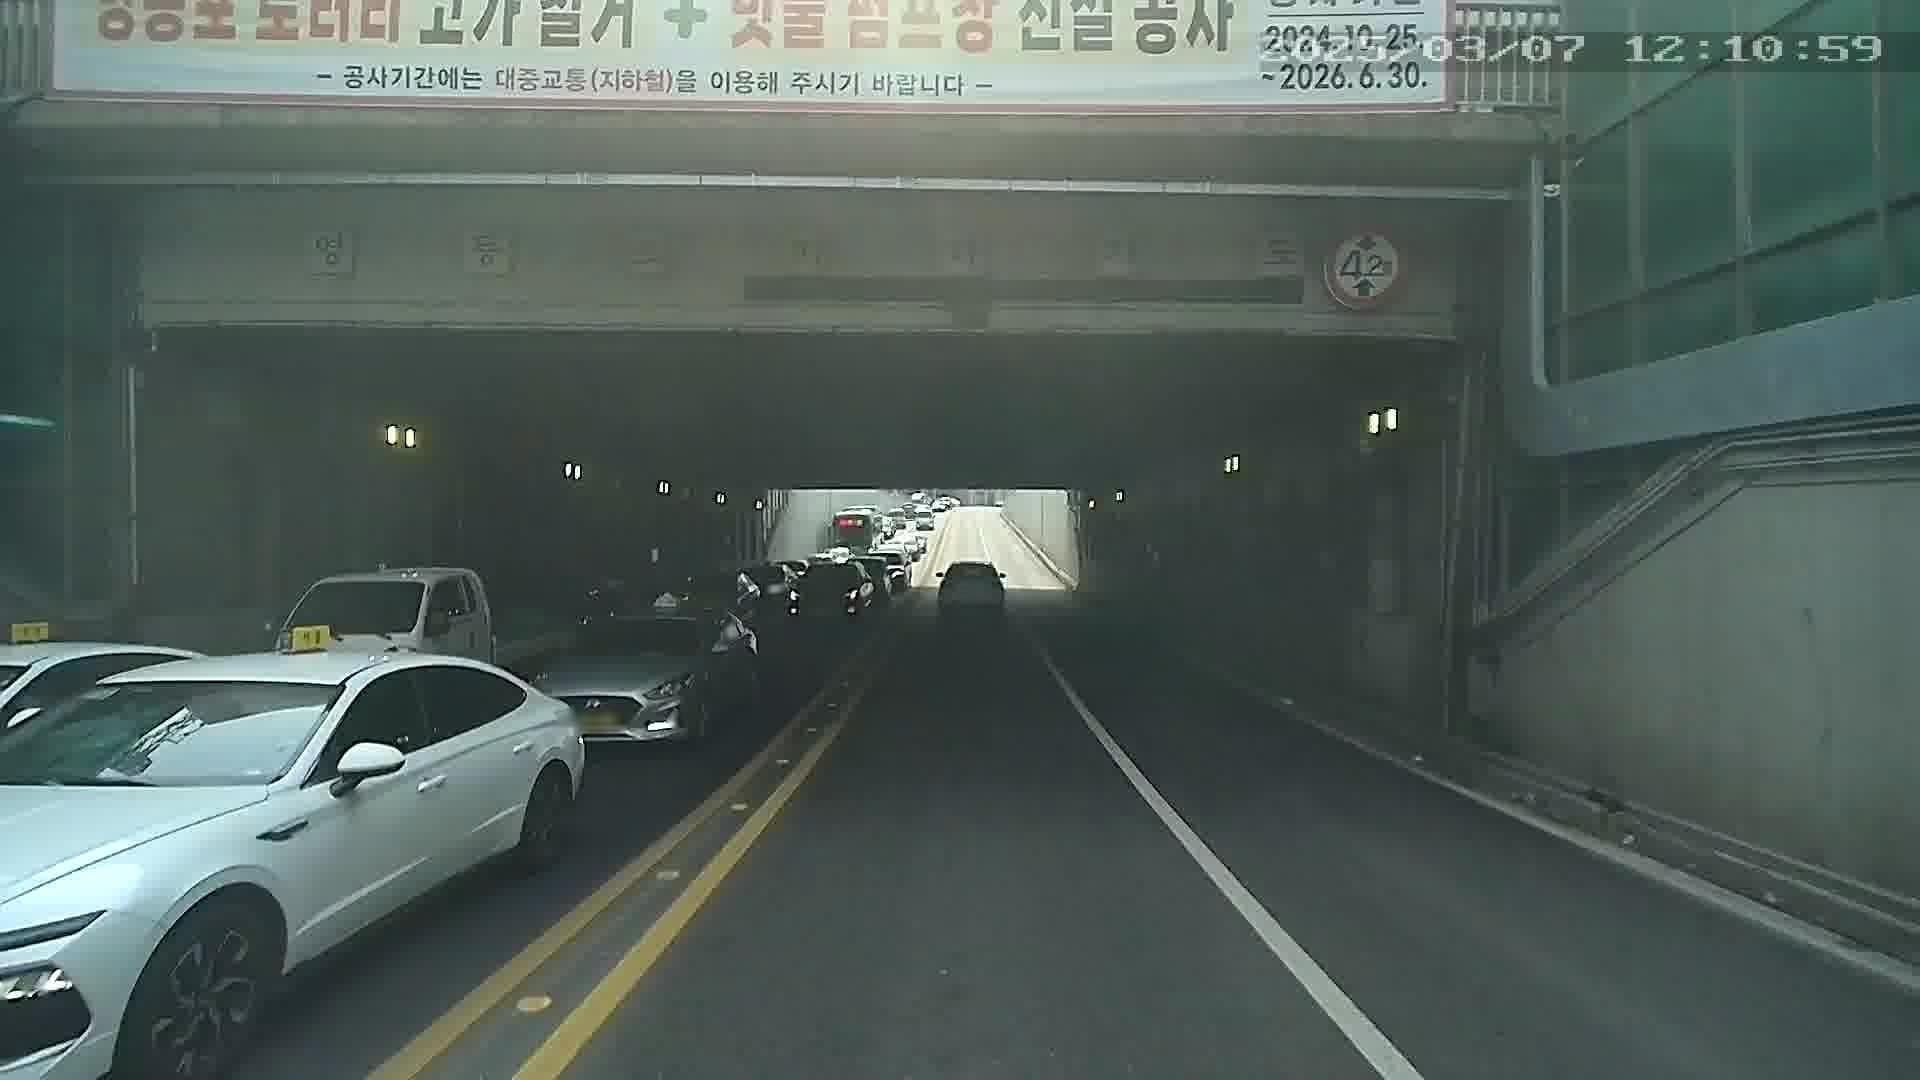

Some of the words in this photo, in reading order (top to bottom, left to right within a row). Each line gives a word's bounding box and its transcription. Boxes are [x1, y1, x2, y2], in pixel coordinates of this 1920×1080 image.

[343, 64, 483, 91] 공사기간에는
[710, 69, 778, 95] 이용해
[790, 70, 859, 96] 주시기
[871, 71, 965, 97] 바랍니다
[1261, 60, 1429, 90] ~2026.6.30.
